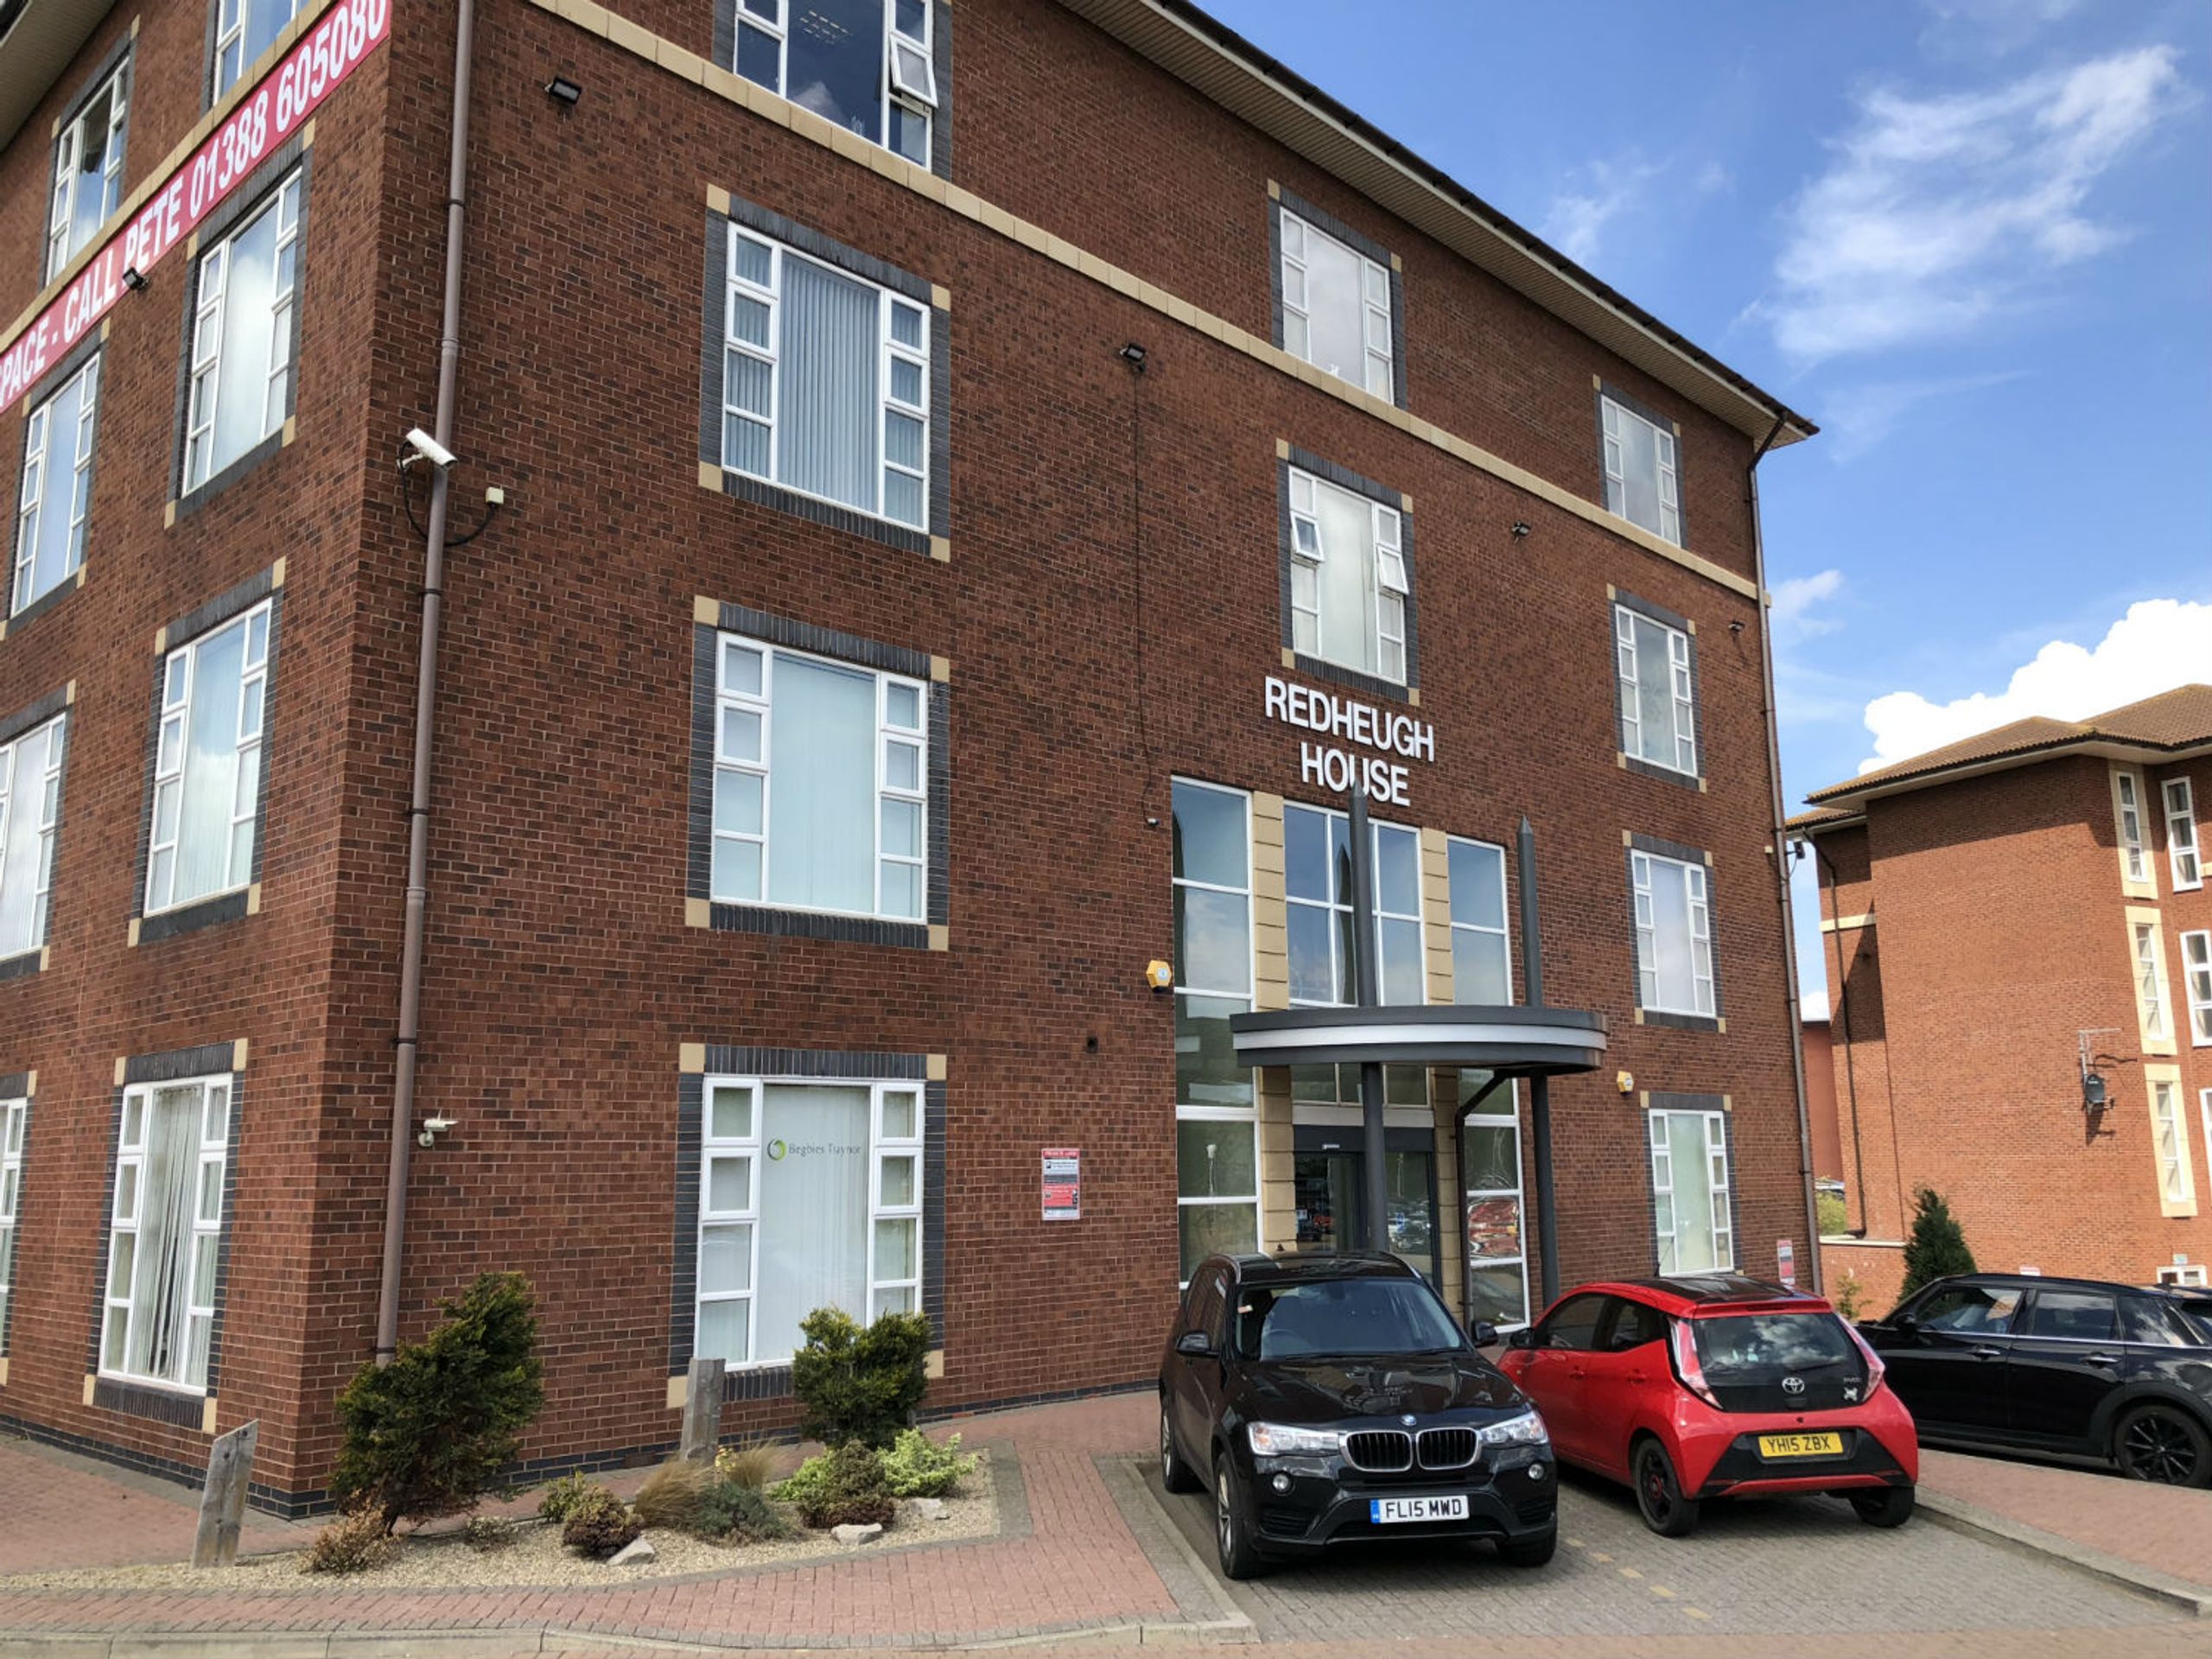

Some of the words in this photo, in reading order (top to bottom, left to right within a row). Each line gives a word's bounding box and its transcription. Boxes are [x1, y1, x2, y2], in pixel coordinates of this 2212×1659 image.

[0, 315, 50, 407] PACE
[64, 247, 117, 344] CALL
[121, 175, 184, 289] PETE
[190, 89, 269, 219] 01388
[1265, 675, 1434, 762] REDHEUGH
[1300, 741, 1410, 807] HOUSE
[789, 1142, 824, 1157] Begbies
[828, 1142, 861, 1157] Traynor
[1766, 1437, 1800, 1452] YH15
[1802, 1435, 1831, 1452] ZBX
[1385, 1501, 1424, 1518] FL15
[1428, 1498, 1462, 1516] MWD
